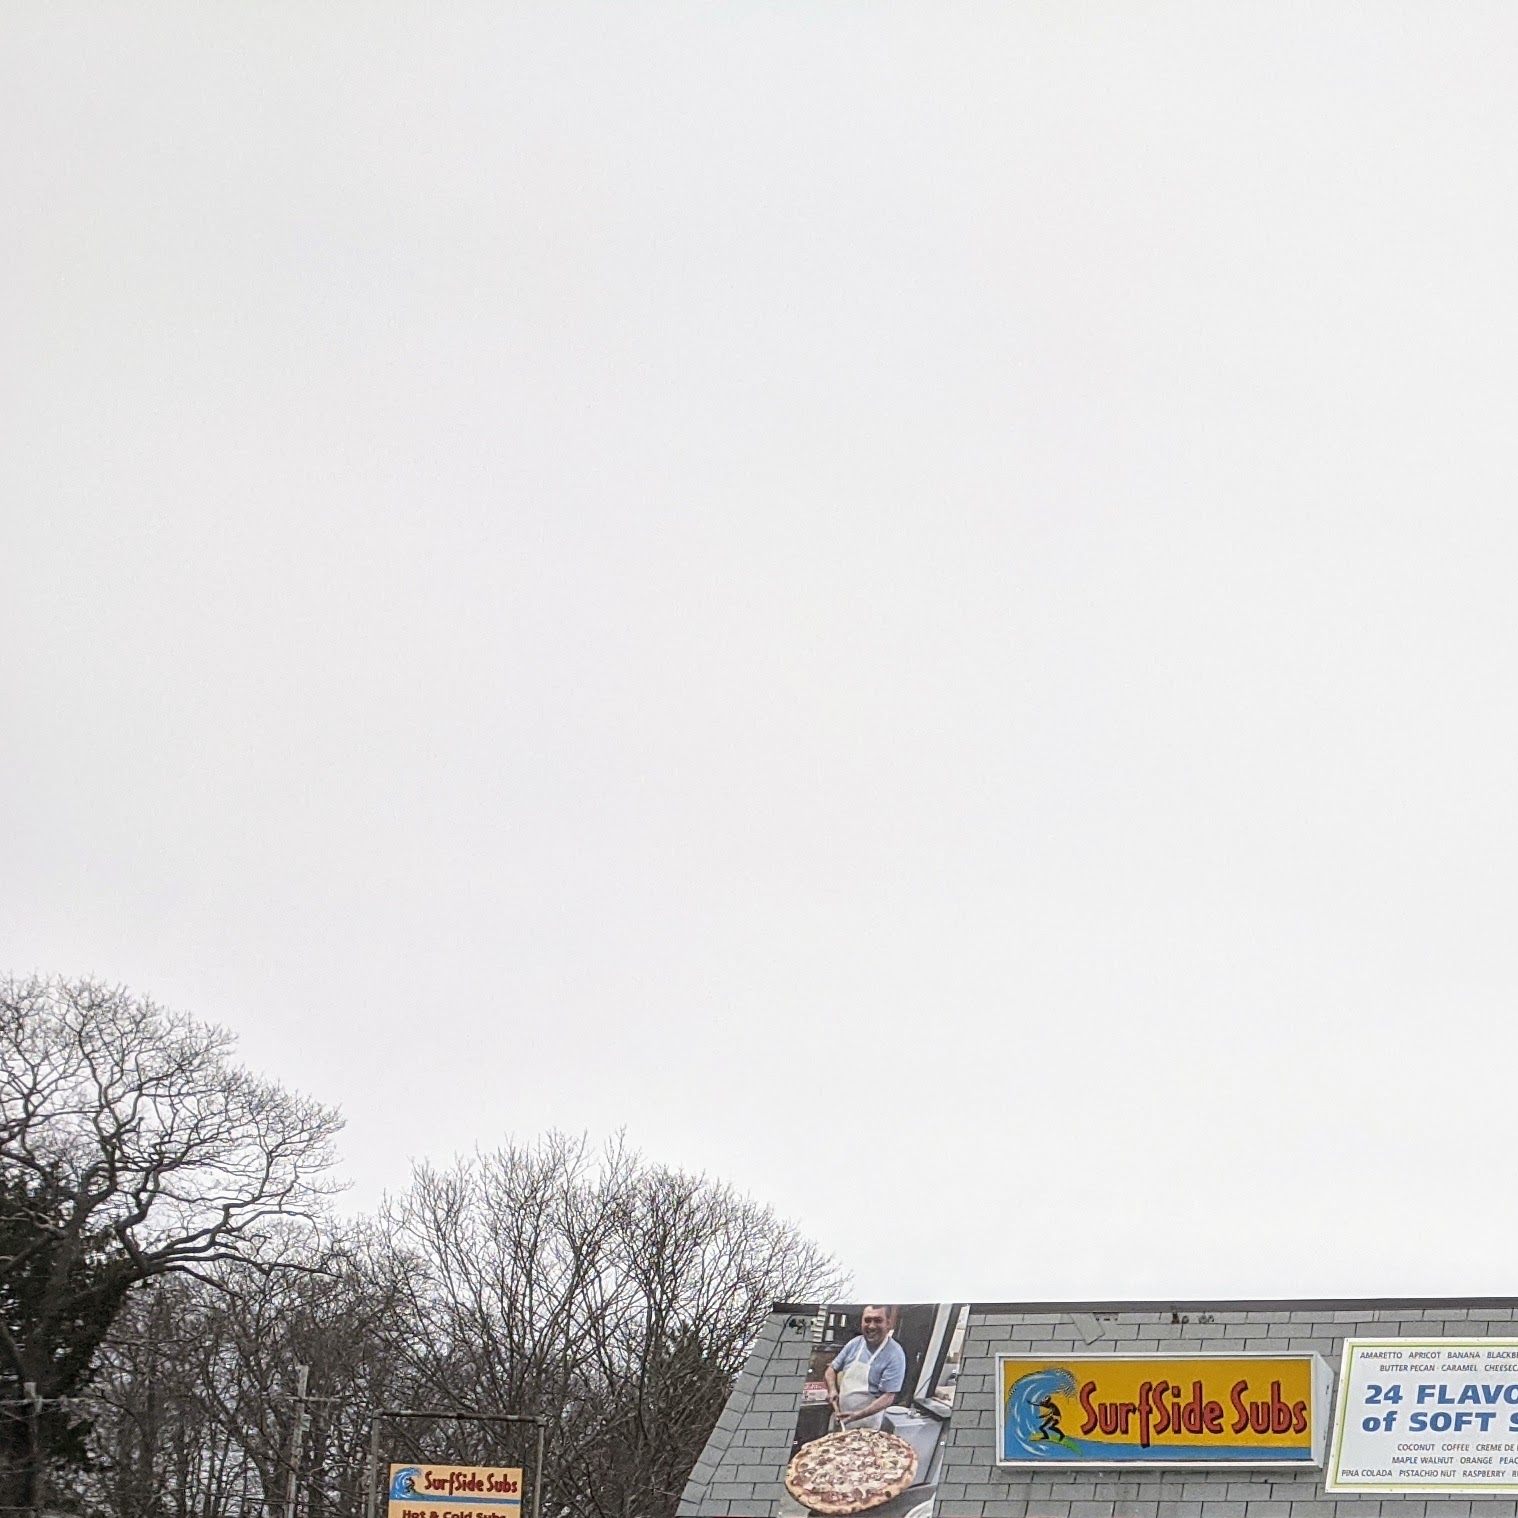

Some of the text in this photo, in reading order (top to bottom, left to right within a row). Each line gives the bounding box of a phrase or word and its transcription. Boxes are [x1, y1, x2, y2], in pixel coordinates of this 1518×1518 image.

[1364, 1384, 1403, 1405] 24
[1079, 1380, 1307, 1449] SurfSide Subs
[1362, 1411, 1398, 1432] of
[1408, 1412, 1496, 1432] SOFT
[1504, 1444, 1515, 1452] DE
[424, 1470, 518, 1496] SurfSide Subs
[1462, 1470, 1505, 1478] RASPBERRY
